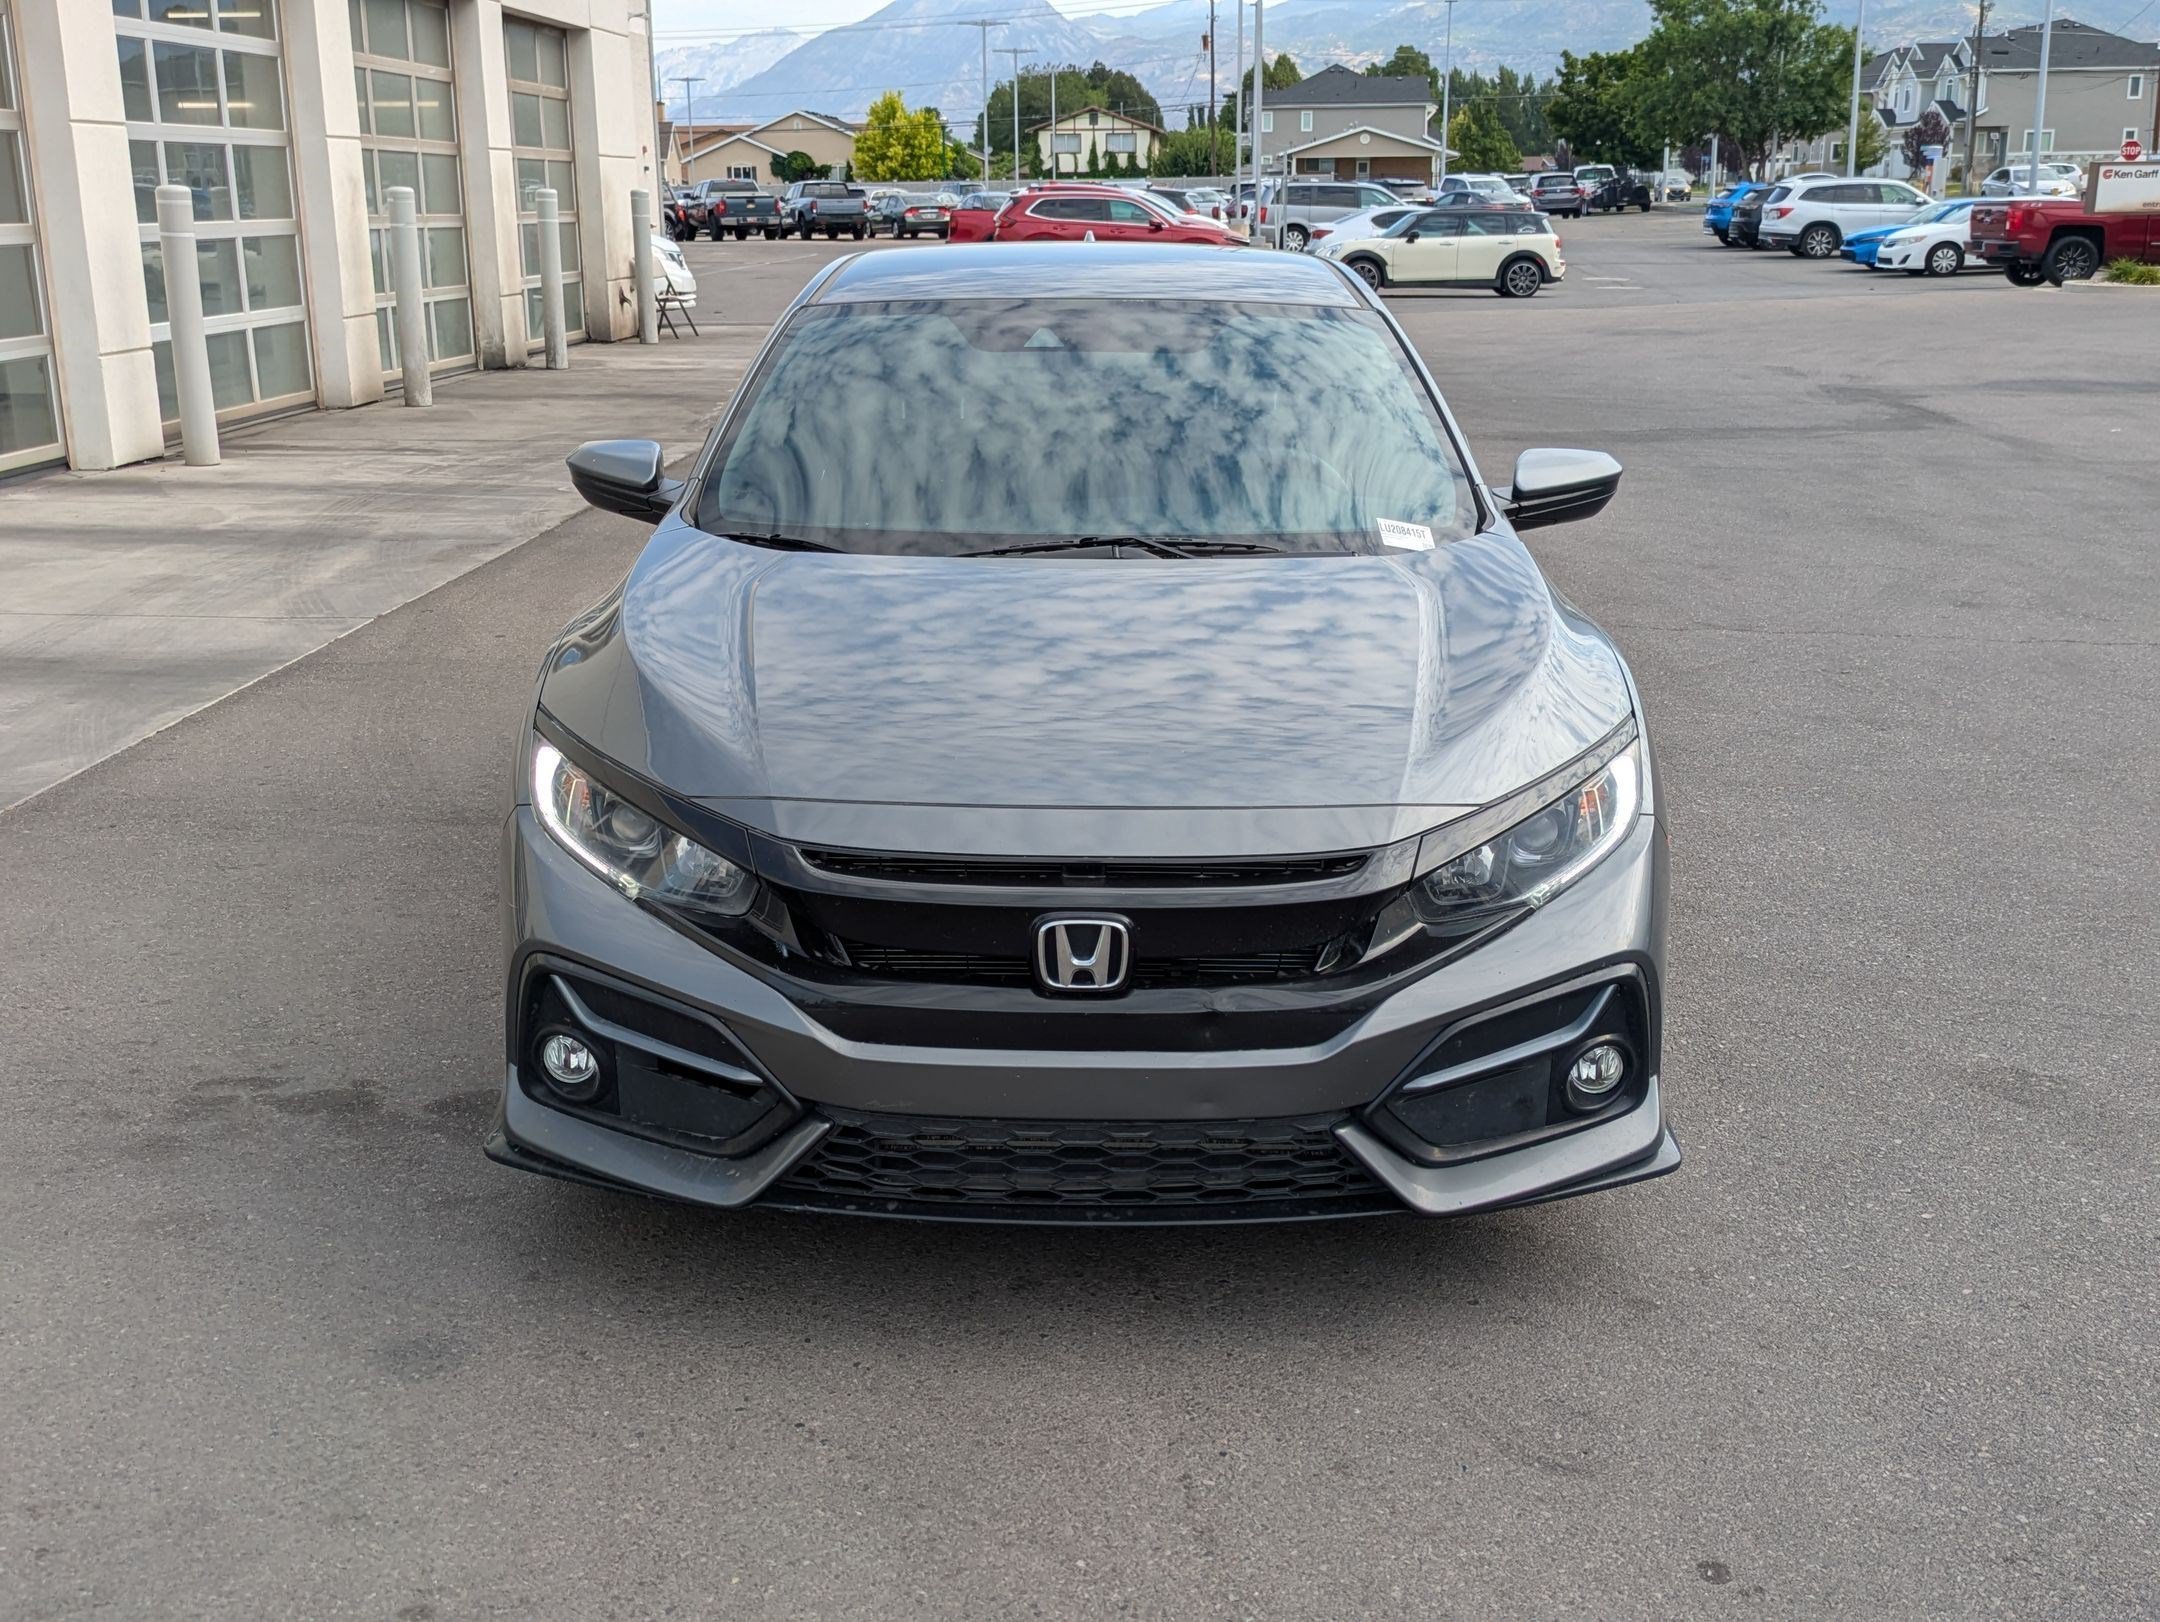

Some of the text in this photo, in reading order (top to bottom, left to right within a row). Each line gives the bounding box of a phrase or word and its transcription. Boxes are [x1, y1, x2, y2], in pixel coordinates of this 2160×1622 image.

[2122, 146, 2141, 155] STOP
[2114, 169, 2159, 179] Ken Garff
